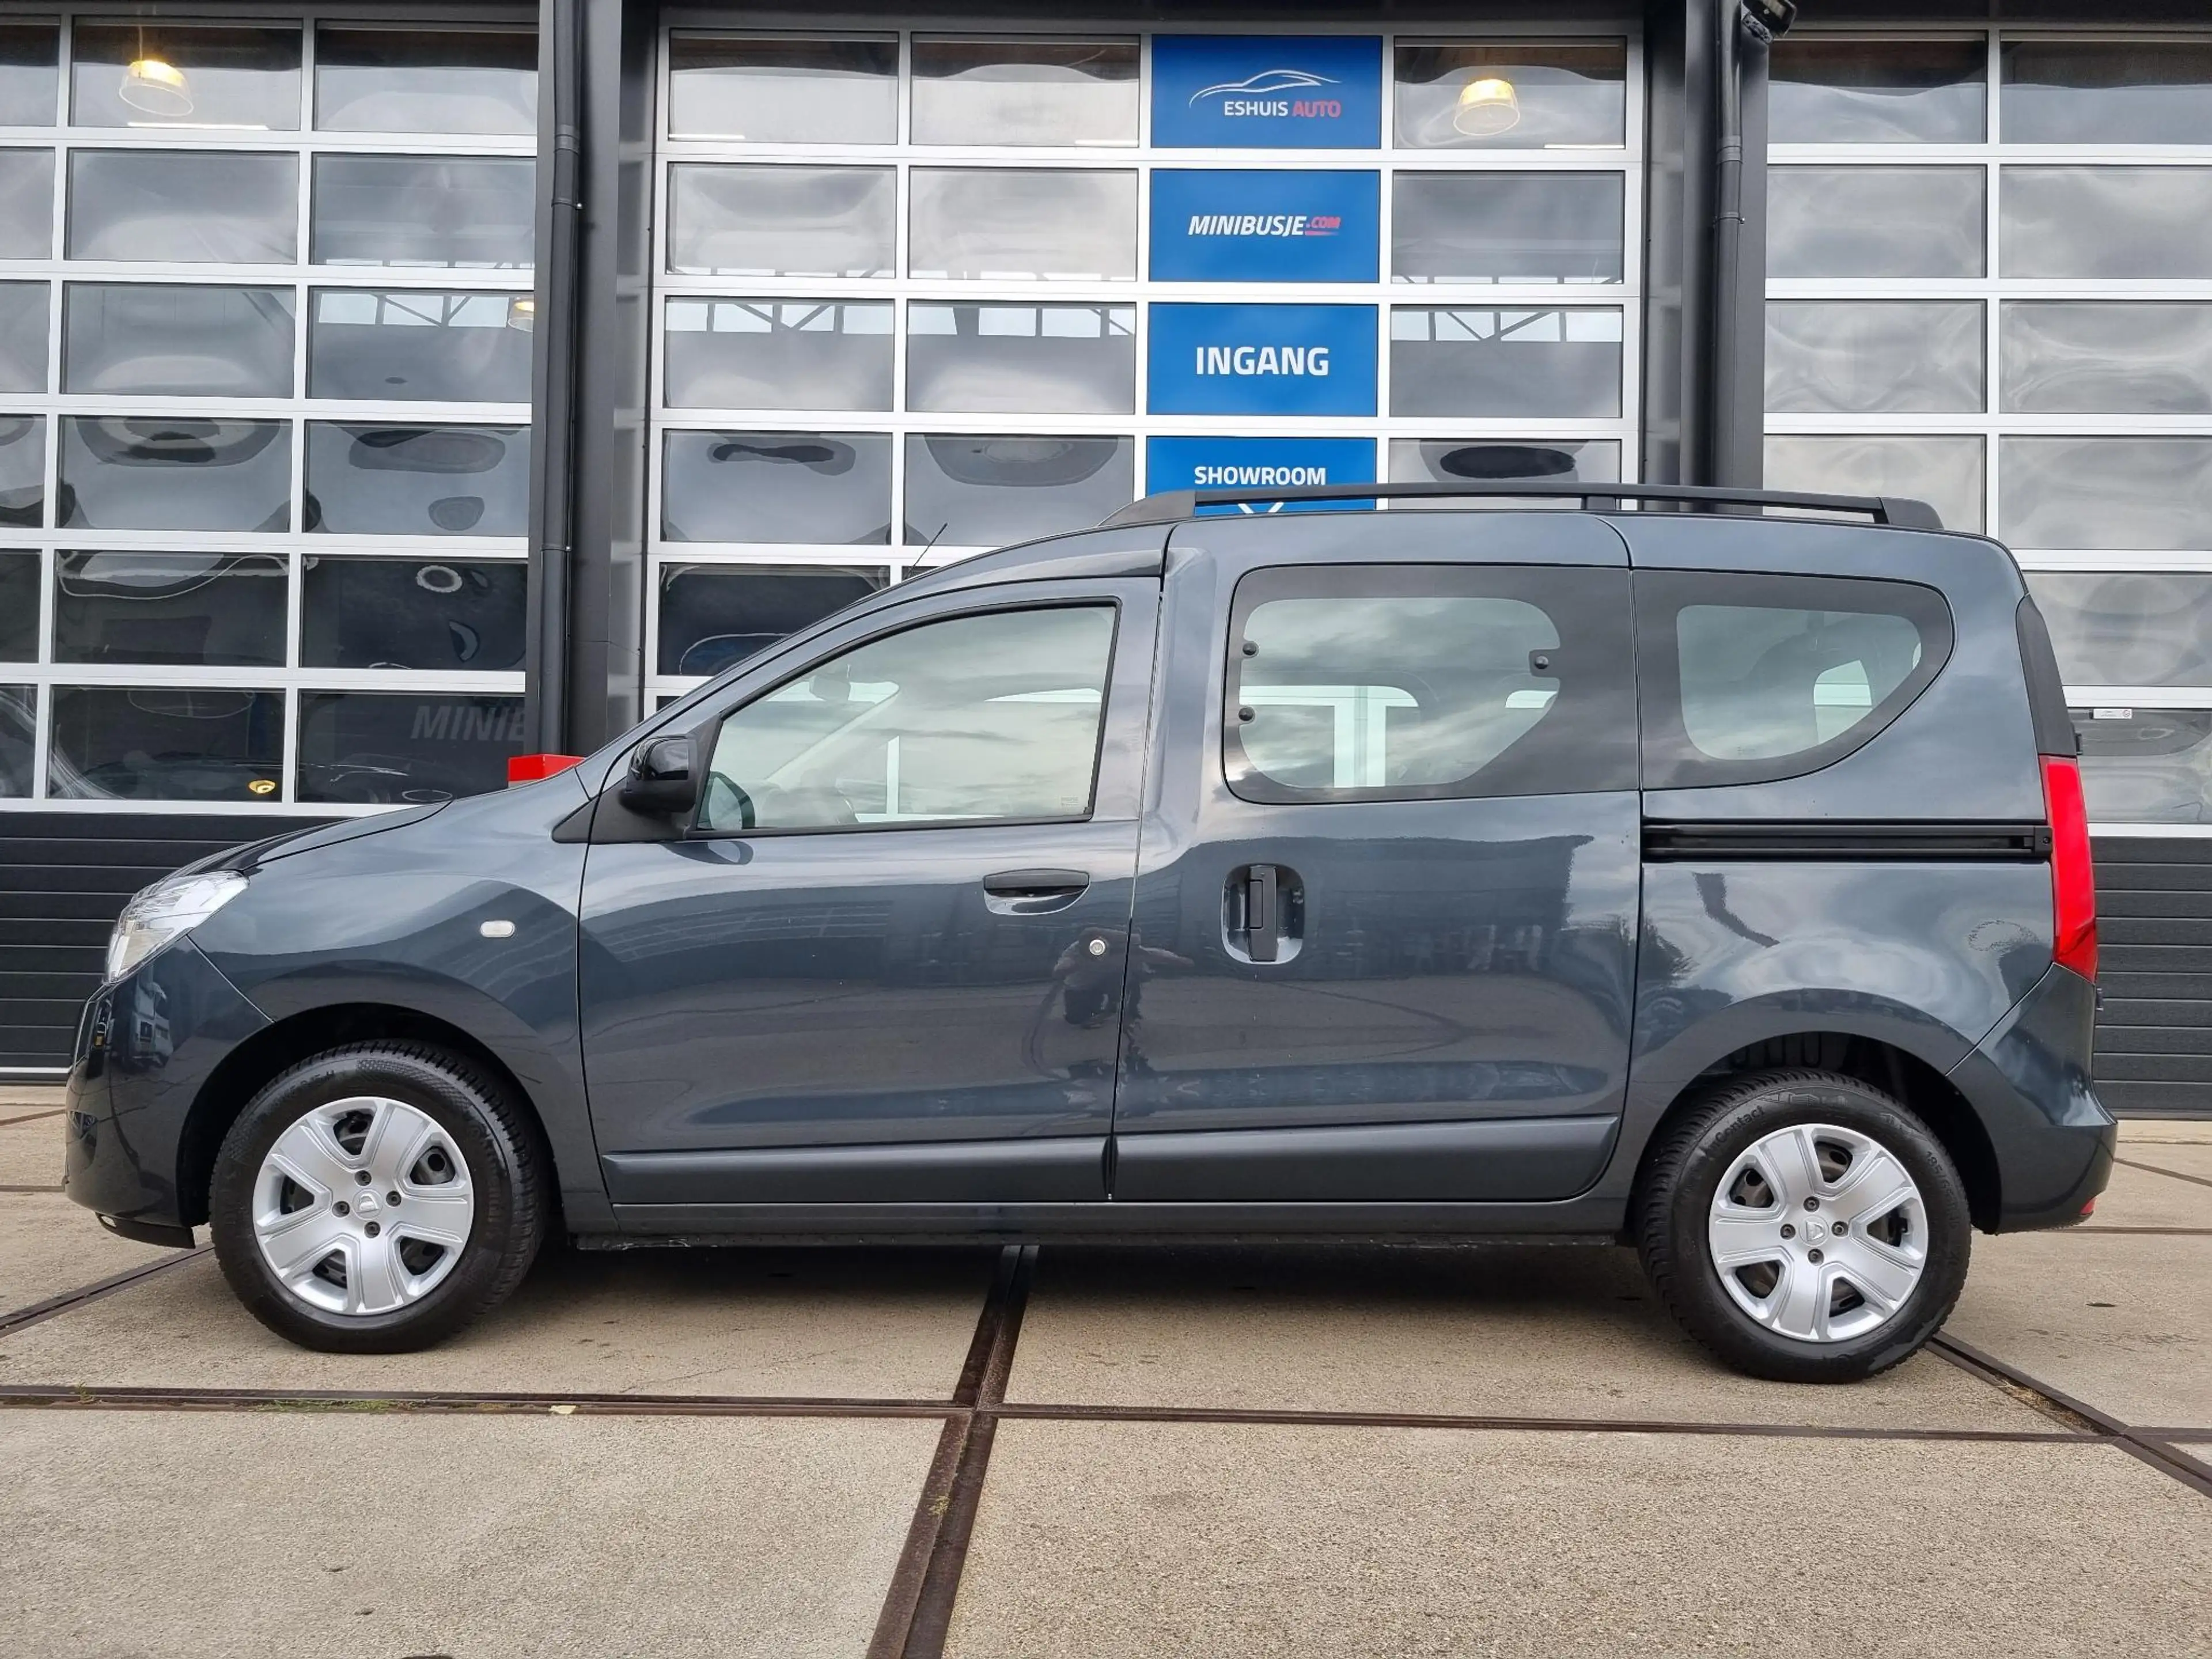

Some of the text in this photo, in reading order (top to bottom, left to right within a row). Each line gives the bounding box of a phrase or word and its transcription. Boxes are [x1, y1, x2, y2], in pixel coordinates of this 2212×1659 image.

[1224, 100, 1341, 118] ESHUIS AUTO
[1196, 347, 1329, 376] INGANG
[1194, 466, 1326, 486] SHOWROOM
